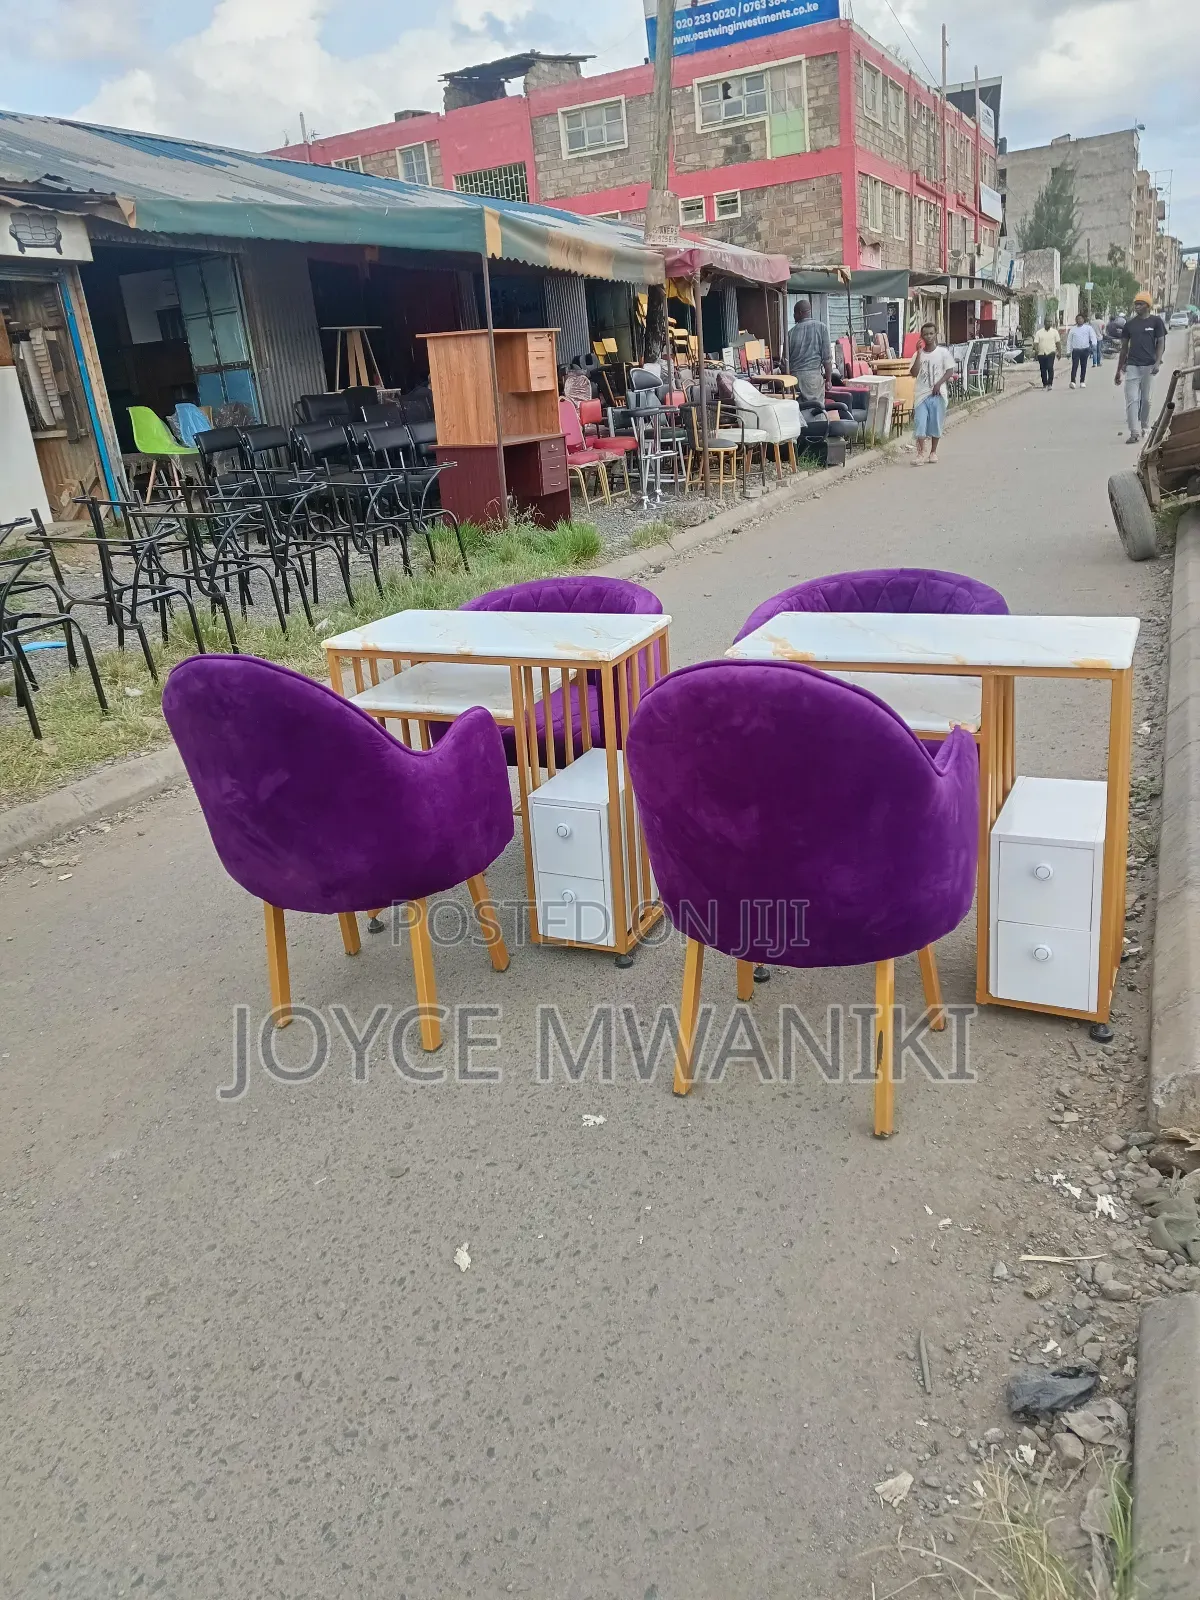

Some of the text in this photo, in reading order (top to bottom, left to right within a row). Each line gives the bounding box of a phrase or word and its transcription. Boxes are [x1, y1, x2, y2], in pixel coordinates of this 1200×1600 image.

[676, 18, 693, 29] 020
[695, 13, 711, 26] 233
[712, 7, 737, 21] 0020
[743, 0, 767, 13] 0763
